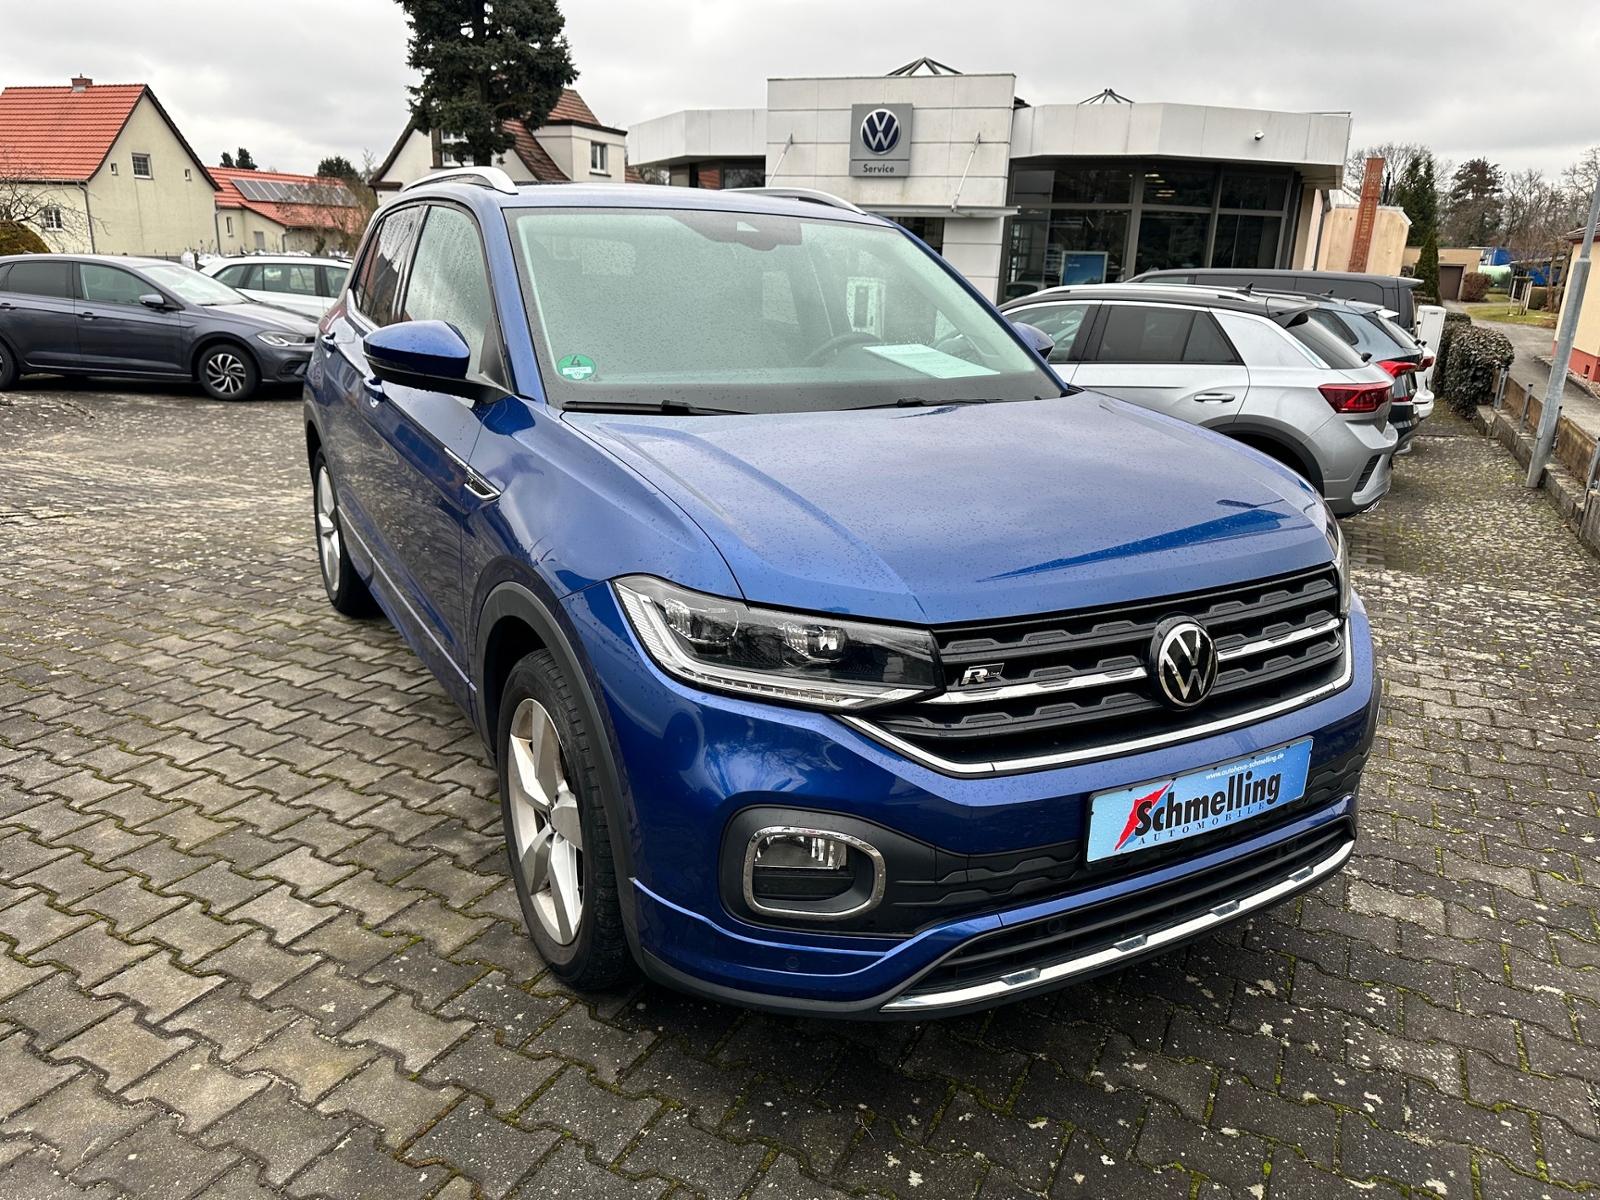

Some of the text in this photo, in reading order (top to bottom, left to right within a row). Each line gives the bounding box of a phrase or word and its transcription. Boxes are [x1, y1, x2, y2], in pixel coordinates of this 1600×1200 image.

[861, 109, 901, 154] VW
[863, 163, 895, 174] Service
[571, 355, 581, 367] 4
[1159, 622, 1218, 707] VW
[1205, 752, 1285, 780] www.autohaus-schmelling.de
[1134, 770, 1282, 837] Schmelling
[1138, 801, 1265, 846] AUTOMOBILE
